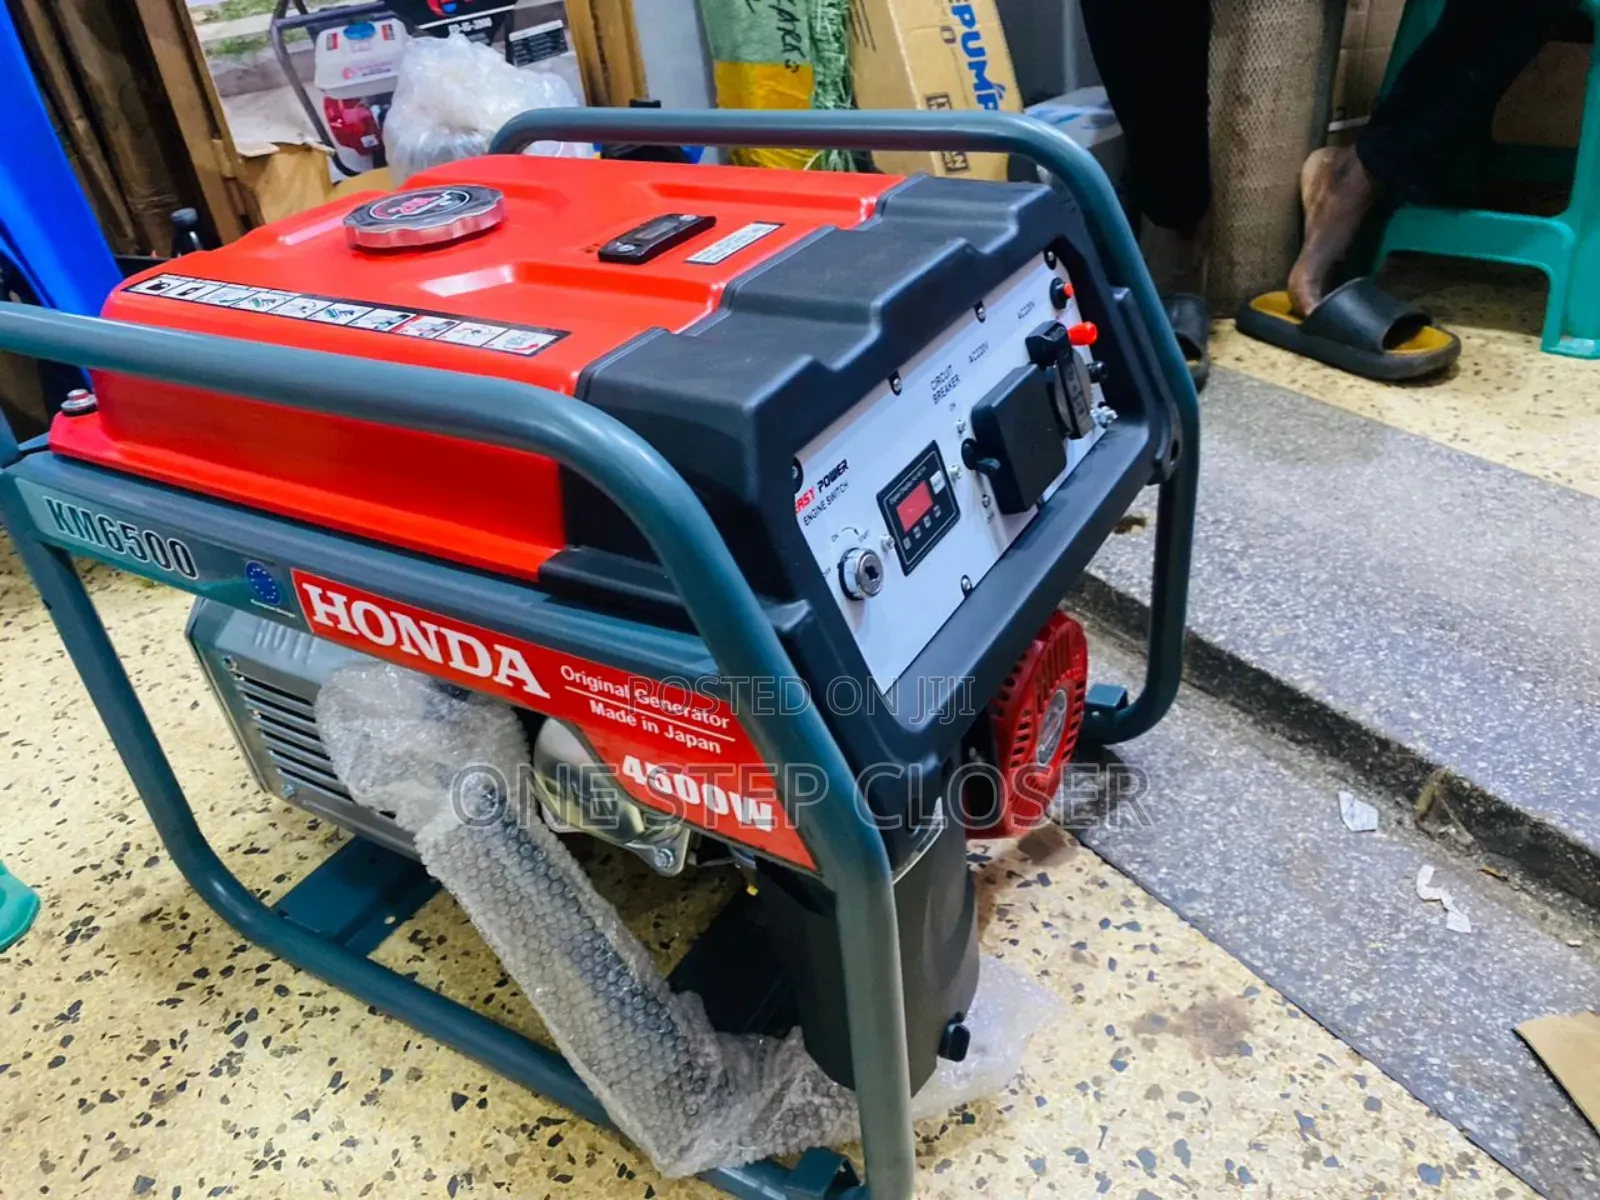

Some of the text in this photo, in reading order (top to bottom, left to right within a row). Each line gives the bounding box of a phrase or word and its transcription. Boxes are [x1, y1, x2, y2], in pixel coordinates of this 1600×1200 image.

[930, 364, 952, 391] CIRCUIT
[932, 373, 960, 405] BREAKER
[803, 480, 850, 526] ENGINE SWITCH
[816, 458, 849, 493] POWER
[43, 495, 199, 580] KM6500
[302, 582, 551, 700] HONDA
[560, 664, 730, 730] Original Generator
[589, 700, 722, 755] Made in Japan
[623, 754, 773, 833] 4500W
